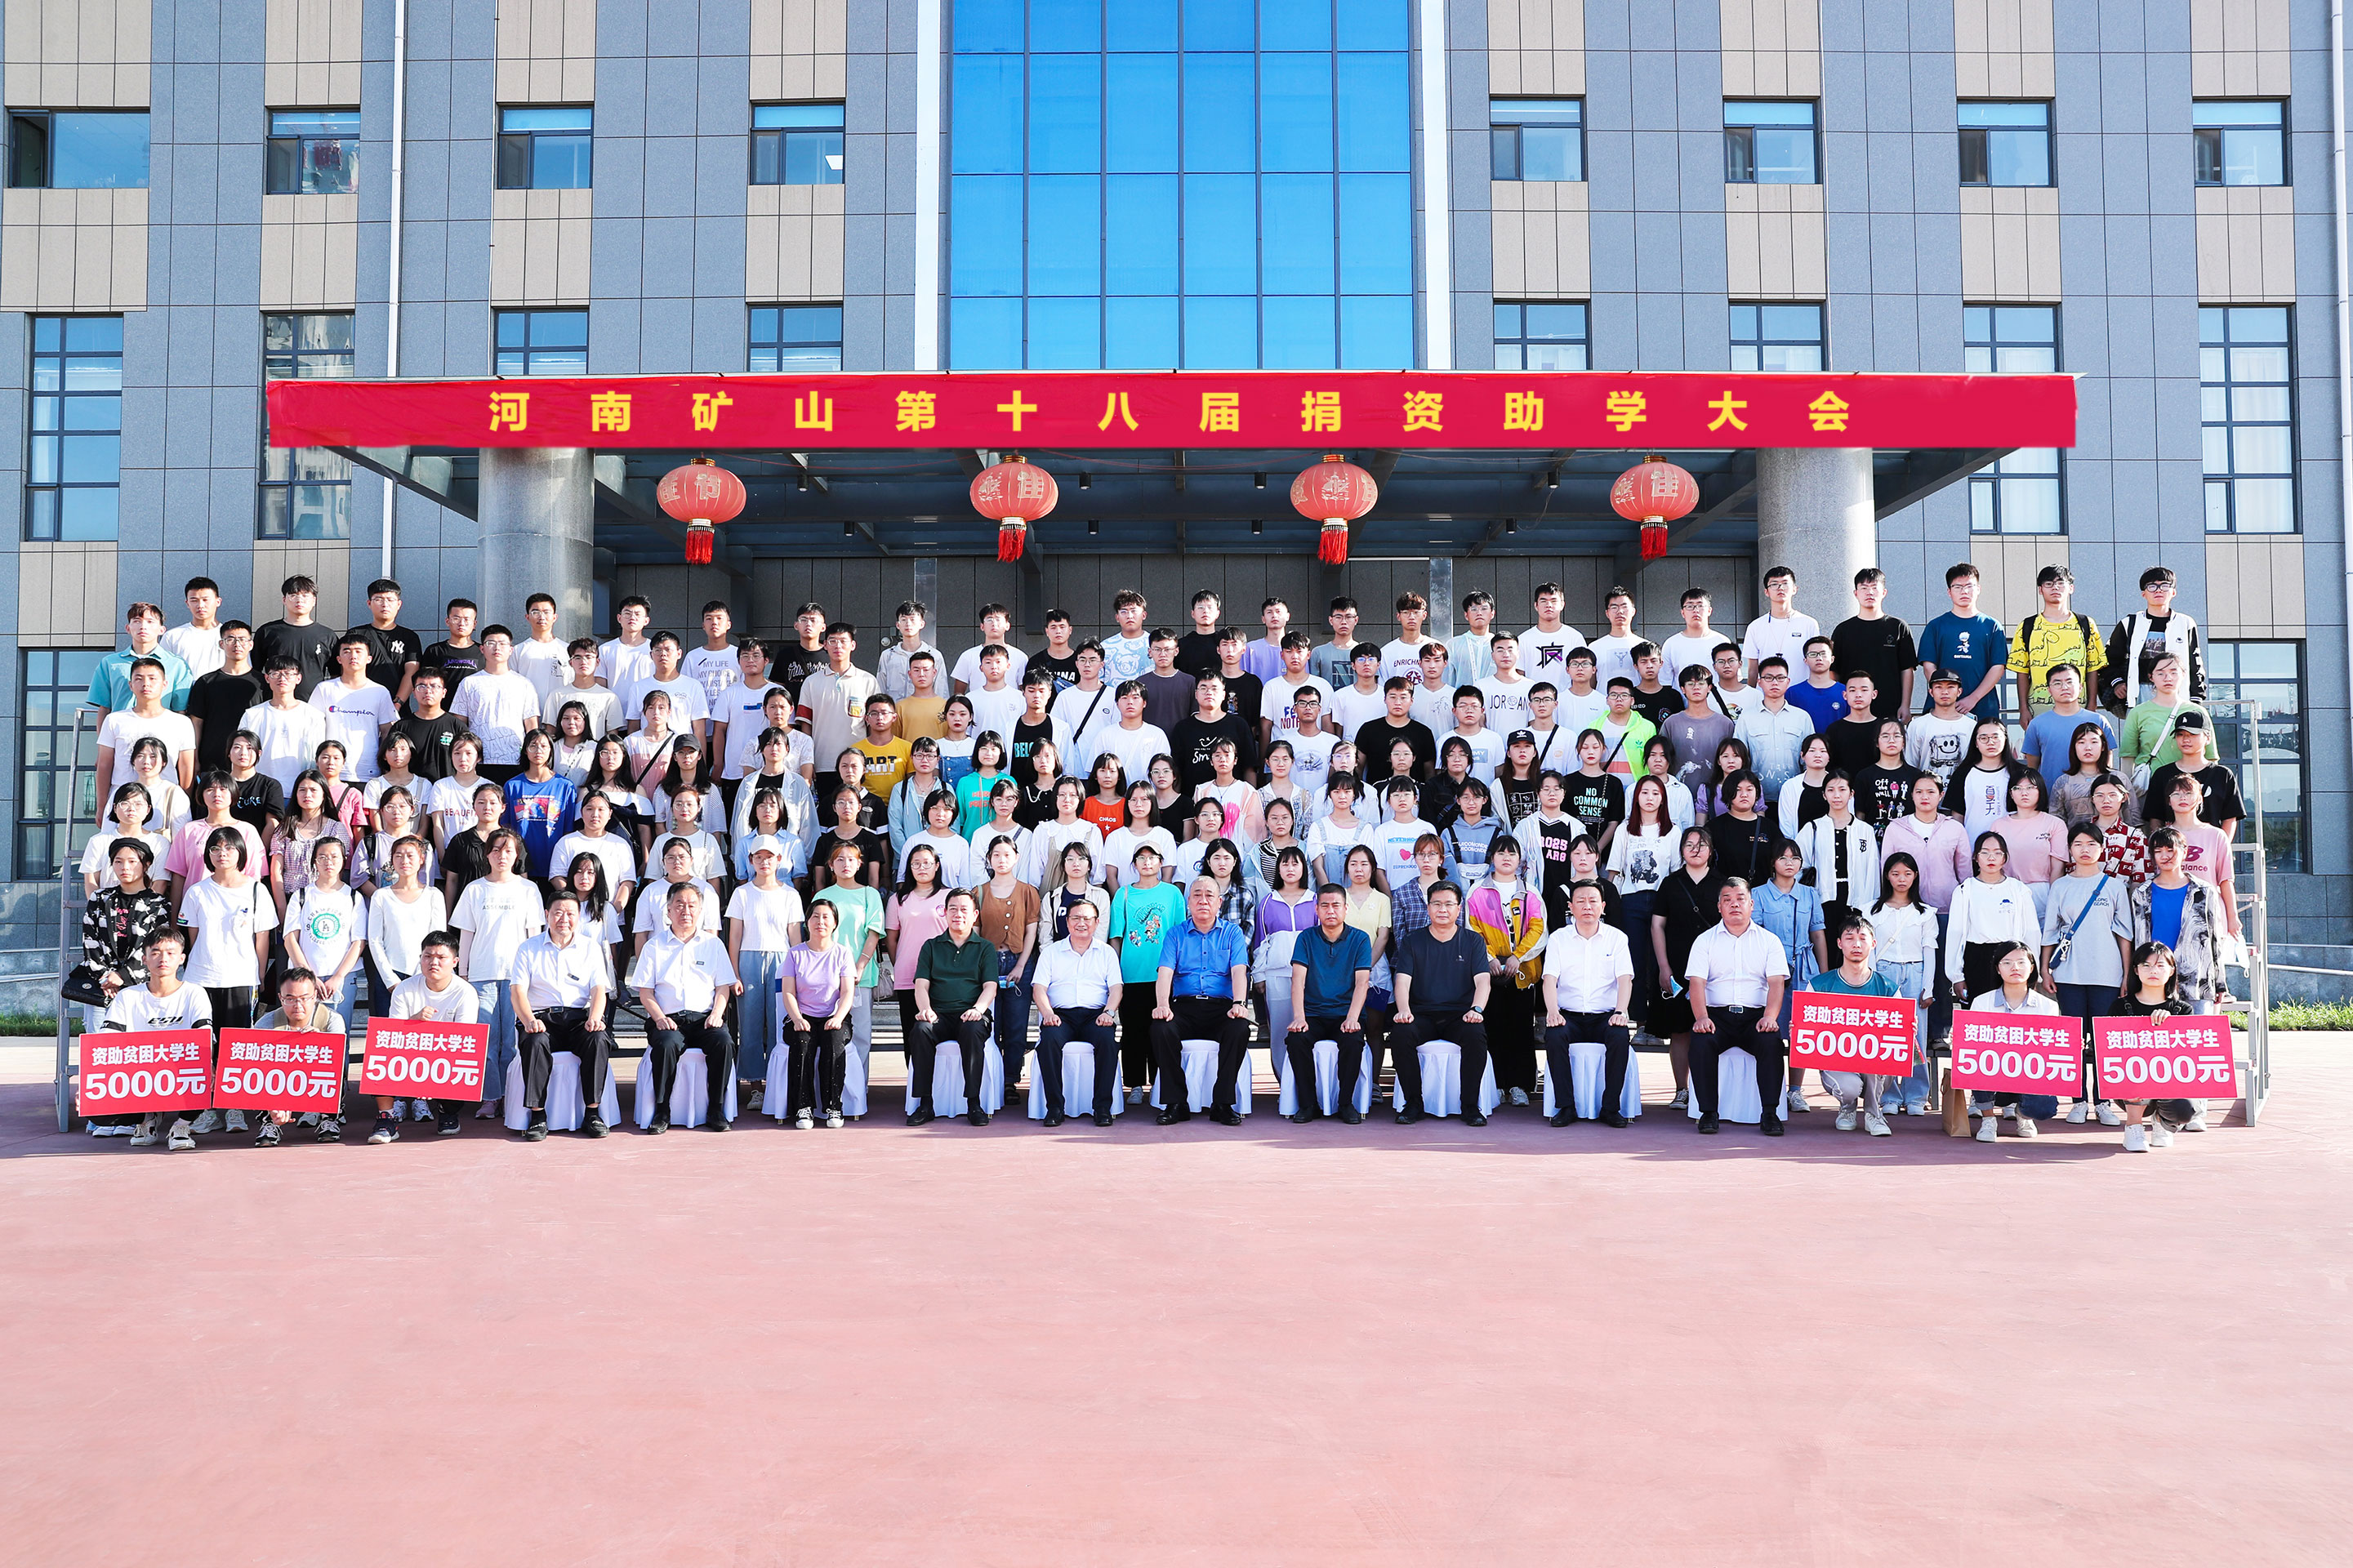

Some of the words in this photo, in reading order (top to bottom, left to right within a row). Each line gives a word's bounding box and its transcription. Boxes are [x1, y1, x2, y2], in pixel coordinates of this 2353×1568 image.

[489, 390, 1849, 432] 河南矿山第十八届捐资助学大会
[1394, 659, 1419, 667] ENRICH
[329, 705, 375, 716] Champion
[1574, 795, 1608, 808] COMMON
[1585, 787, 1597, 796] NO
[1579, 806, 1602, 817] SENSE
[1803, 1004, 1903, 1029] 资助贫困大学生
[376, 1031, 476, 1054] 资助贫困大学生
[1795, 1029, 1909, 1062] 5000元
[1963, 1023, 2070, 1048] 资助贫困大学生
[2106, 1029, 2220, 1049] 资助贫困大学生
[92, 1043, 200, 1066] 资助贫困大学生
[230, 1041, 333, 1064] 资助贫困大学生
[366, 1054, 479, 1086] 5000元
[1957, 1048, 2077, 1082] 5000元
[2102, 1055, 2230, 1084] 5000元
[85, 1067, 207, 1100] 5000元
[221, 1067, 337, 1098] 5000元
